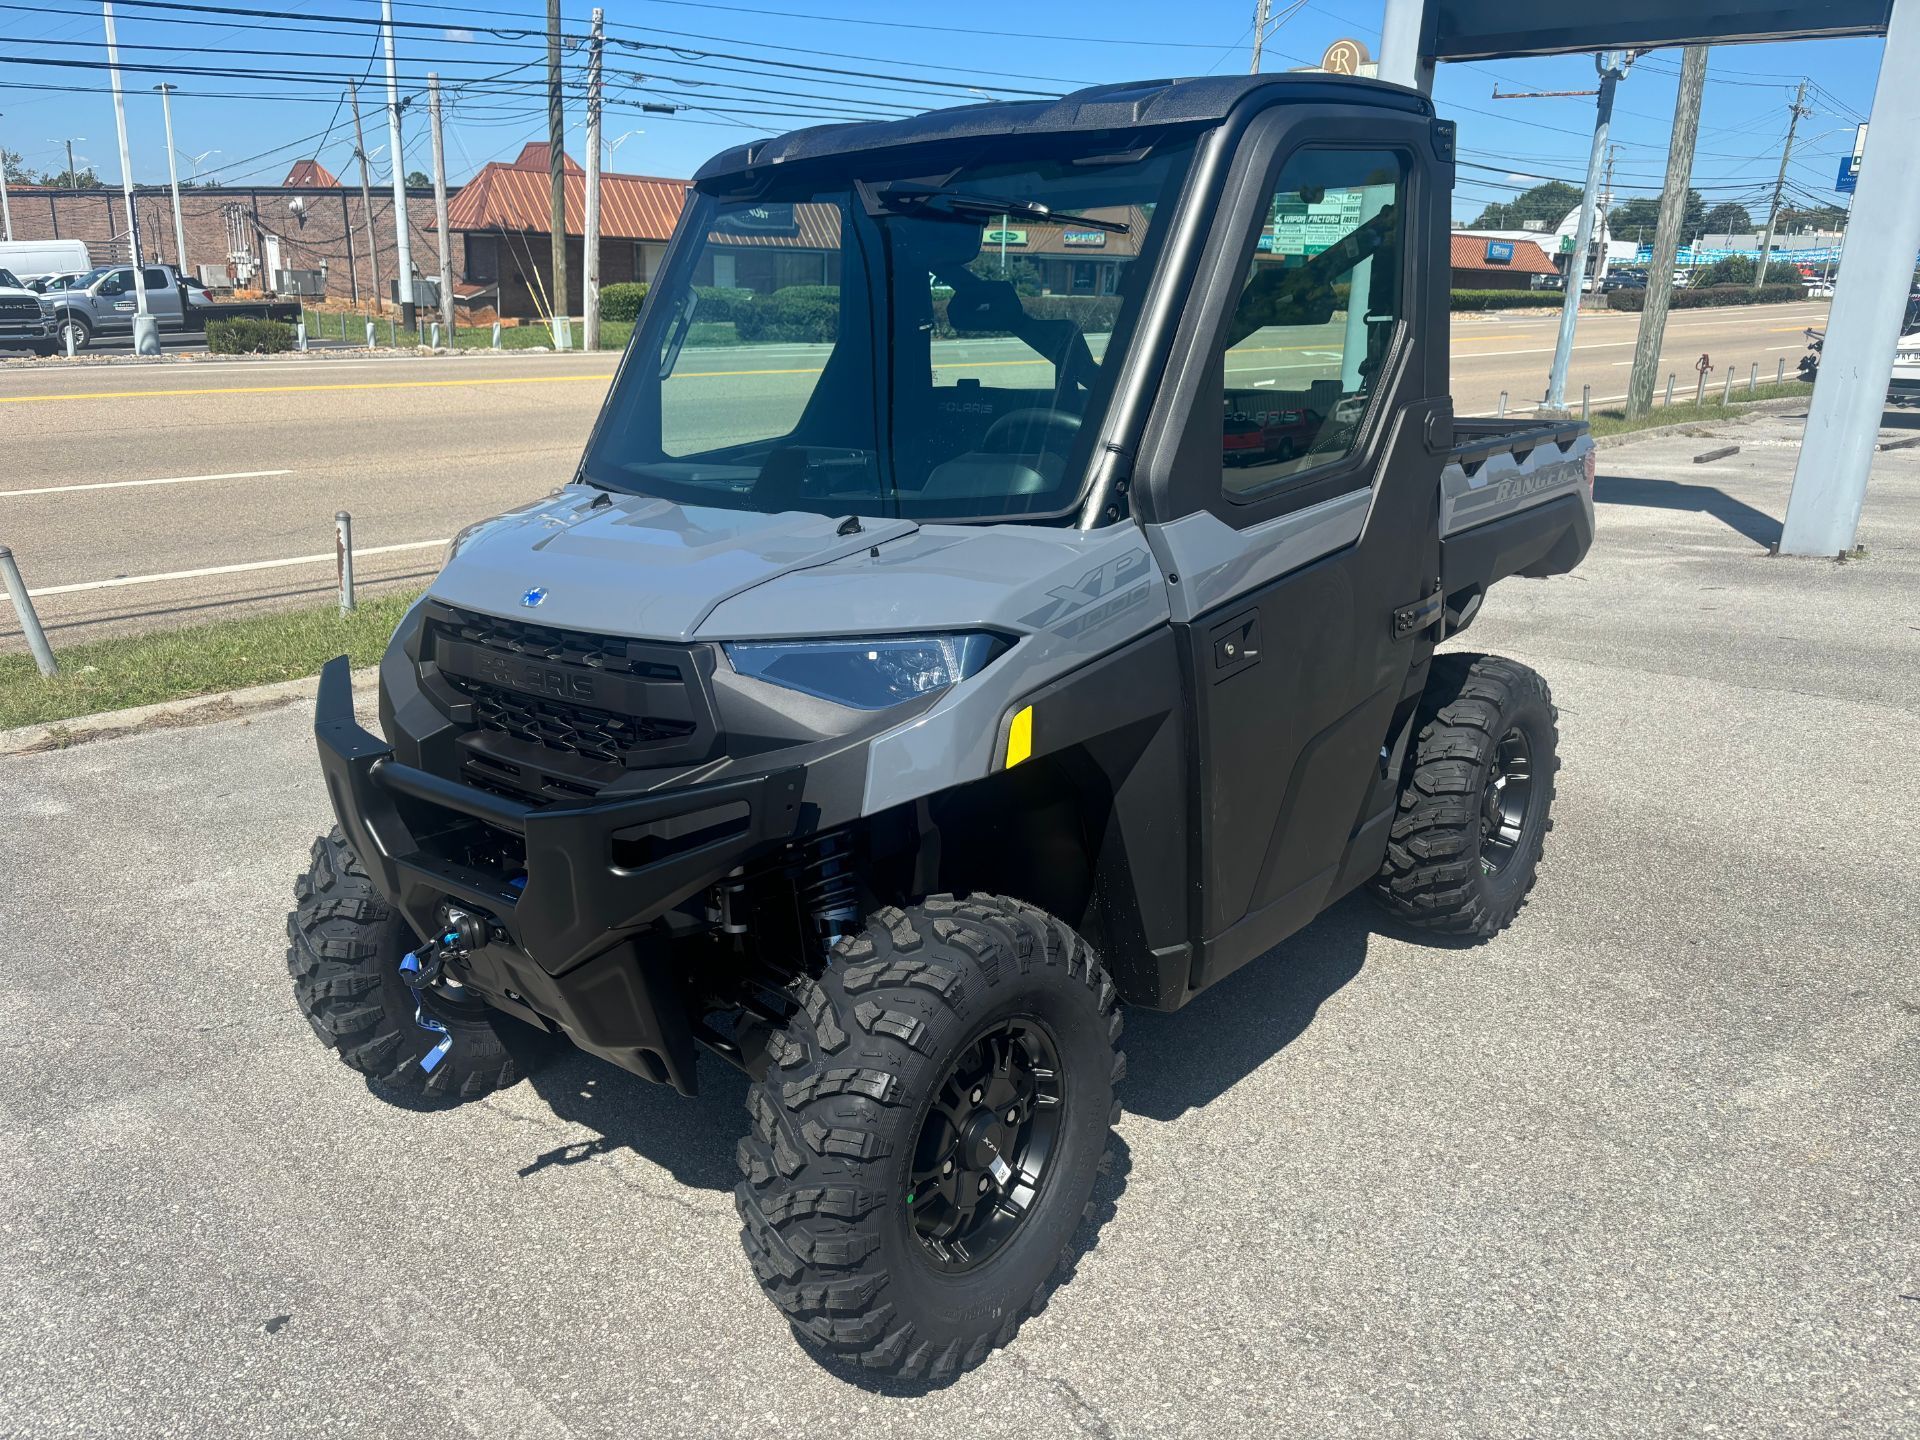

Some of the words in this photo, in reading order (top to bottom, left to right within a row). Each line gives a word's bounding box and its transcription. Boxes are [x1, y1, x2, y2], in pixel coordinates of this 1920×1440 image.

[1331, 48, 1351, 75] R
[1284, 215, 1306, 224] VAPOR
[1308, 215, 1339, 224] FACTORY
[1901, 352, 1911, 360] KY
[938, 399, 993, 414] POLARIS
[1224, 410, 1298, 422] POLARIS
[1496, 468, 1569, 503] RANGER
[1043, 547, 1150, 626] XP
[478, 652, 594, 702] POLARIS
[982, 1136, 998, 1152] XP
